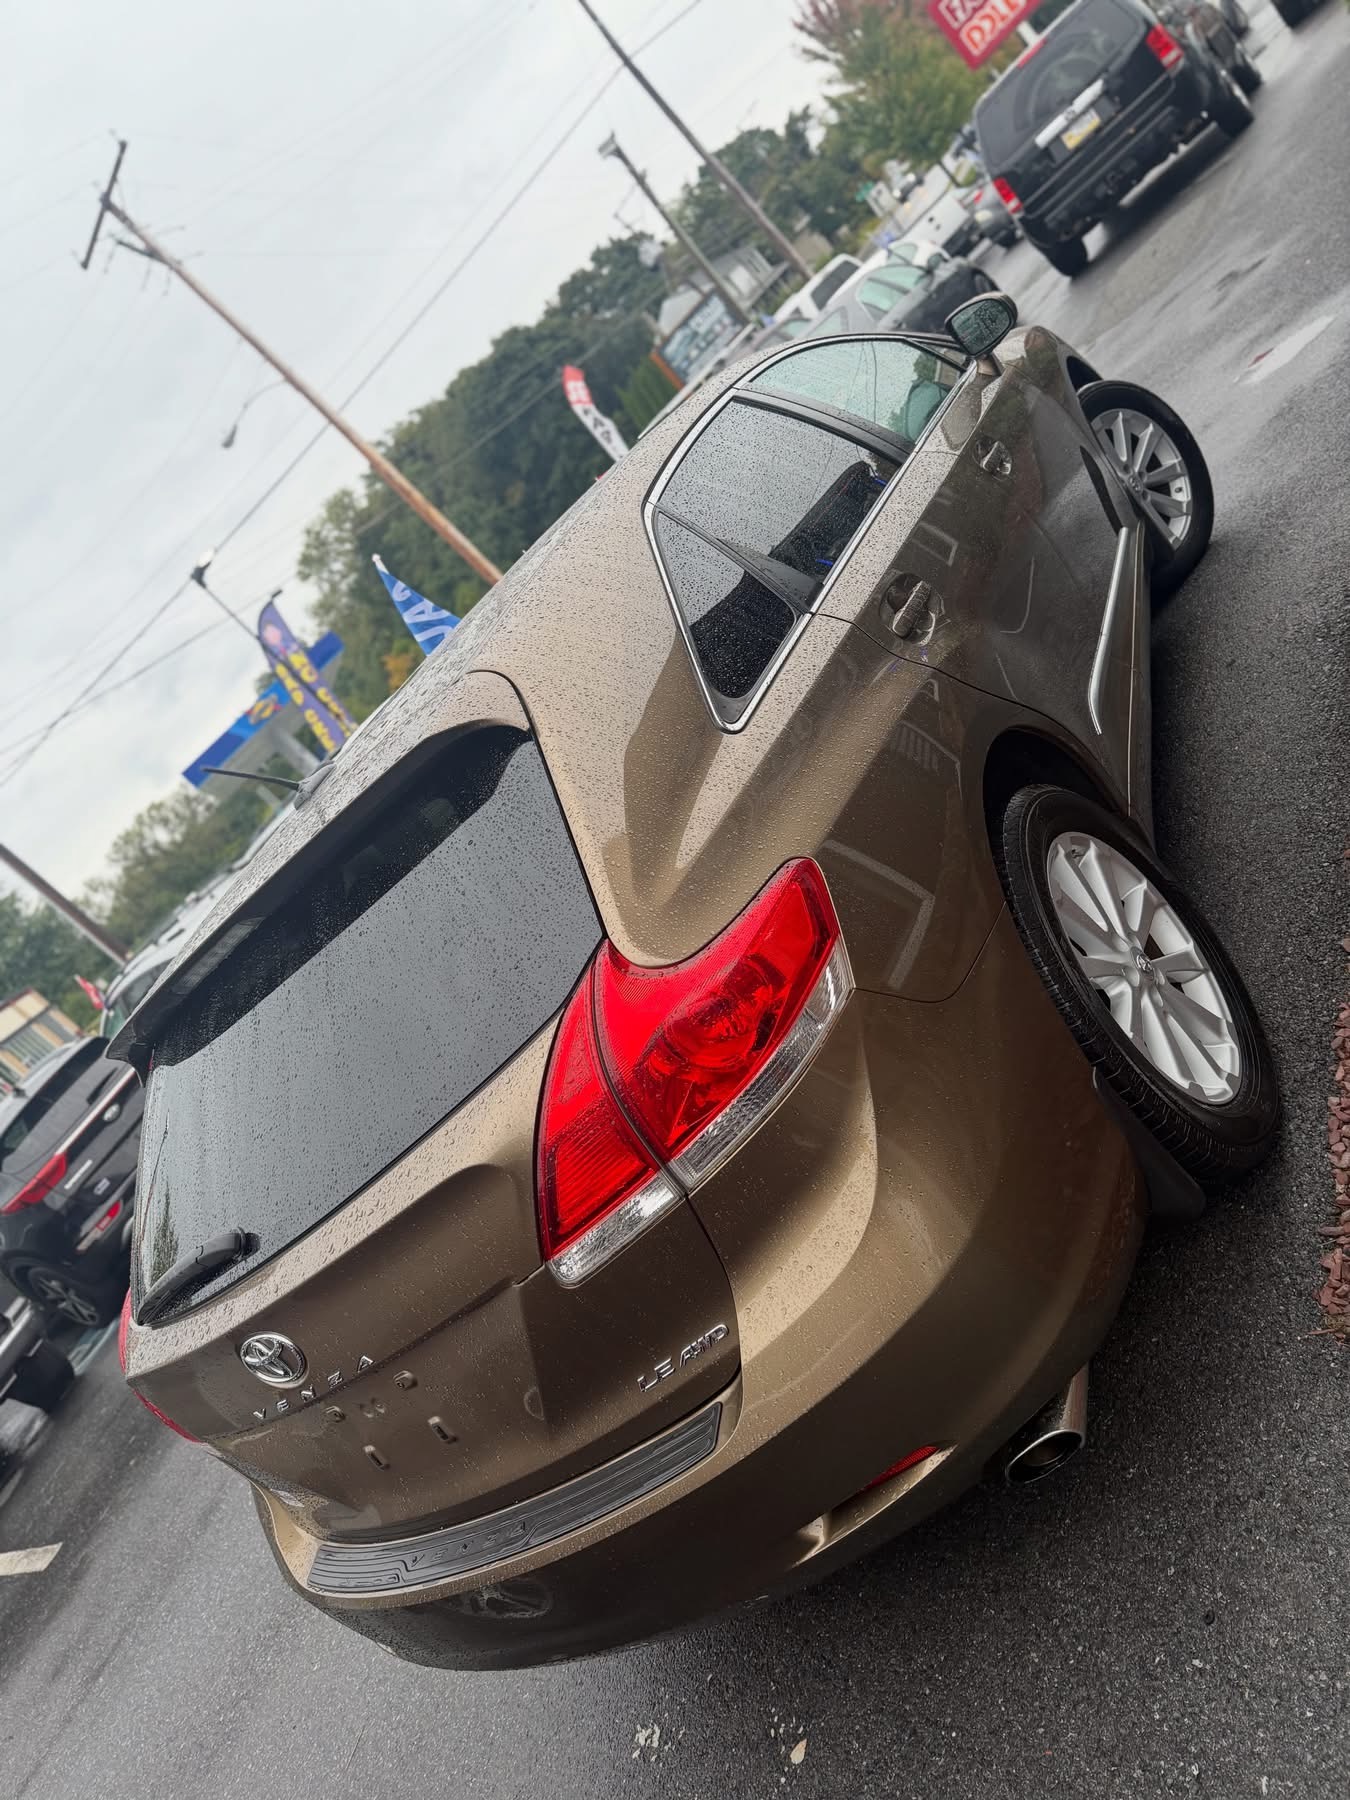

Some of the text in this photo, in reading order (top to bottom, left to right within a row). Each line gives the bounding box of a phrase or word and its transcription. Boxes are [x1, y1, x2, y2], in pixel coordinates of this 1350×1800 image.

[252, 1355, 375, 1420] VENZA
[637, 1323, 730, 1393] LE AWD
[410, 1521, 526, 1568] VENZA
